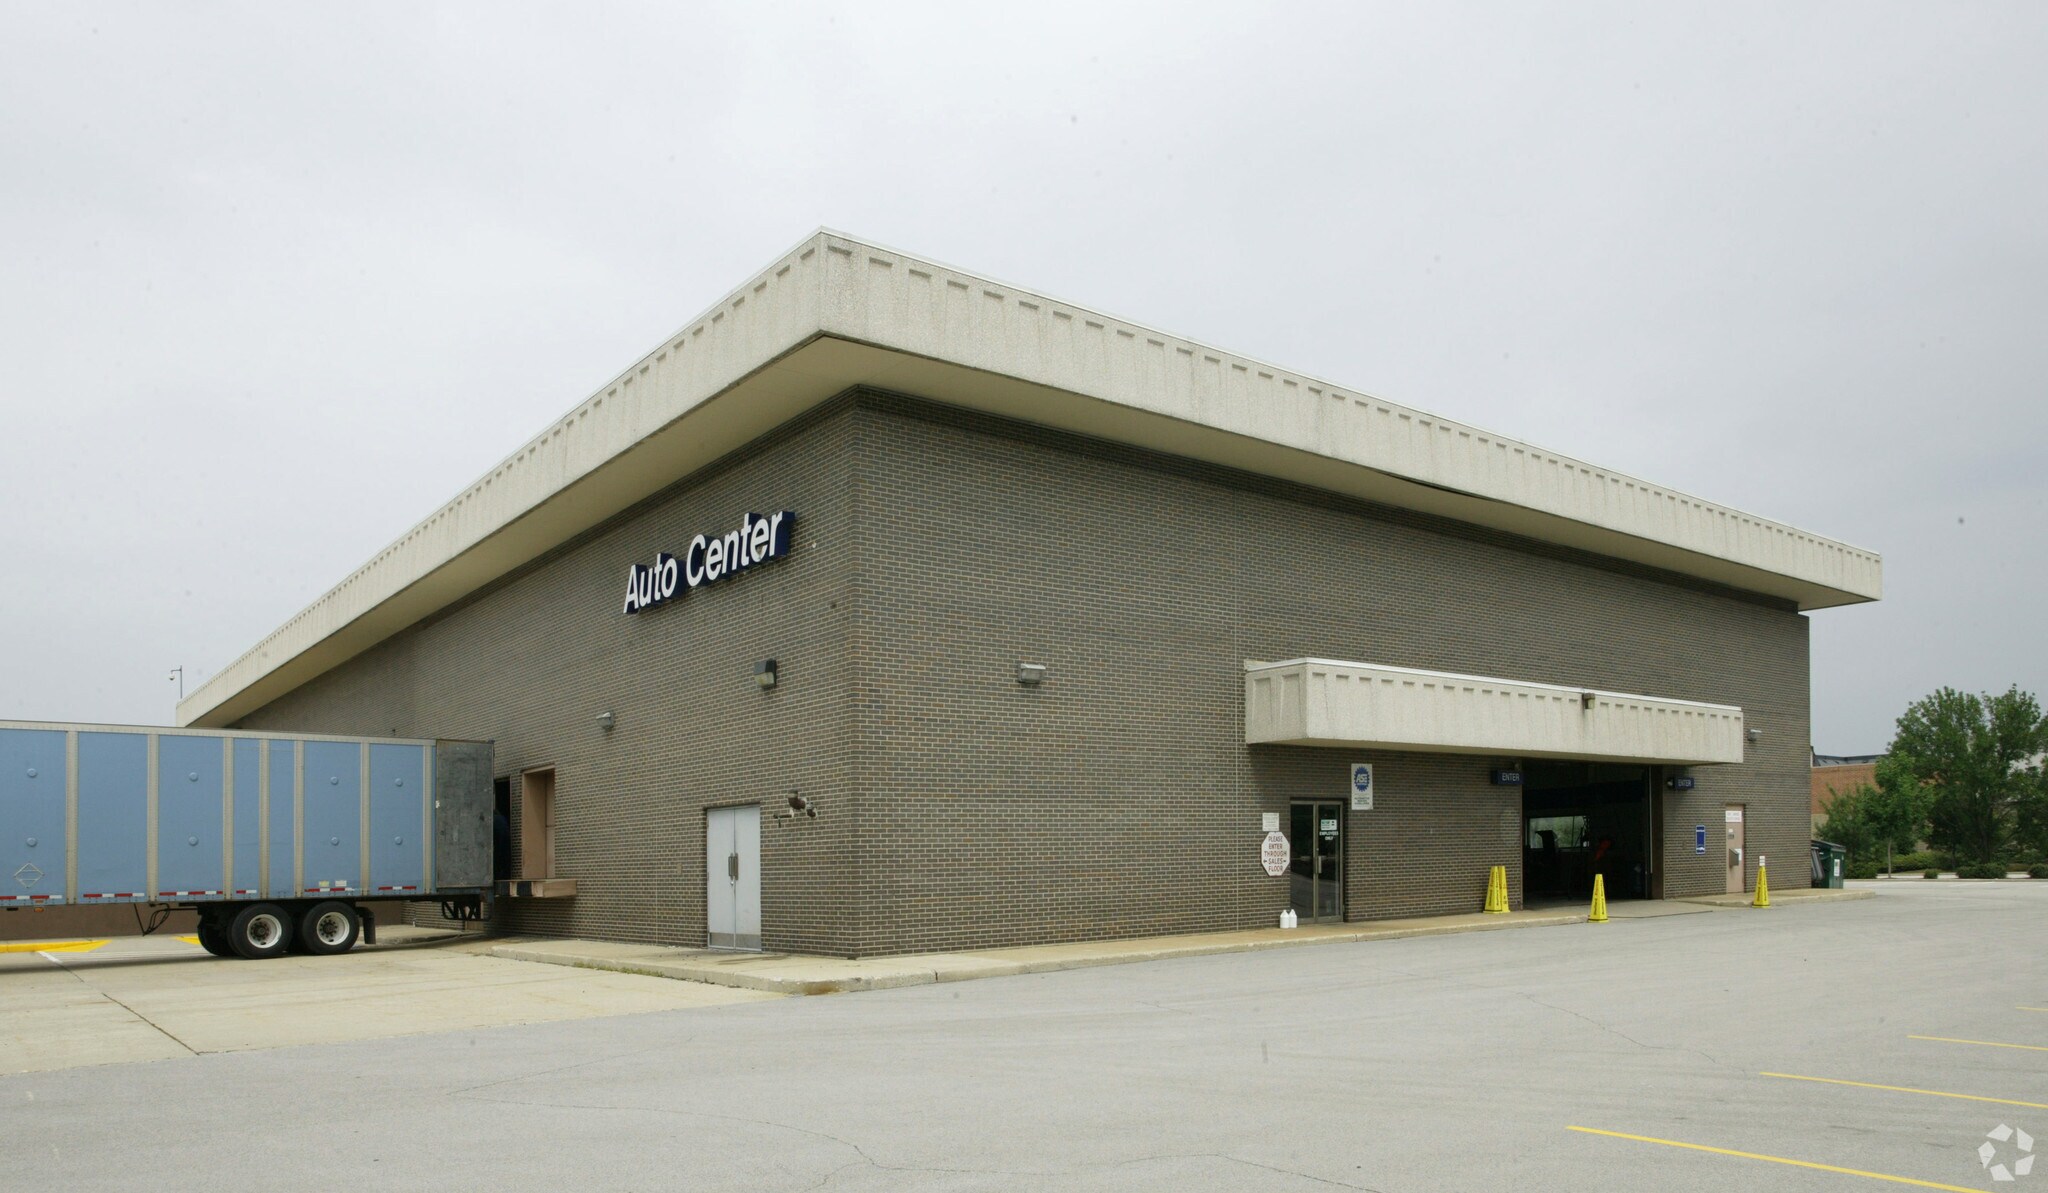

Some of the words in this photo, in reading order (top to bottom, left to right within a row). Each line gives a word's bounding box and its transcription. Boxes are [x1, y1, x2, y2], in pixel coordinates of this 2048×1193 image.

[623, 552, 679, 614] Auto
[686, 510, 785, 587] Center
[1356, 774, 1368, 782] ASE
[1502, 772, 1520, 782] ENTER
[1678, 778, 1692, 786] ENTER
